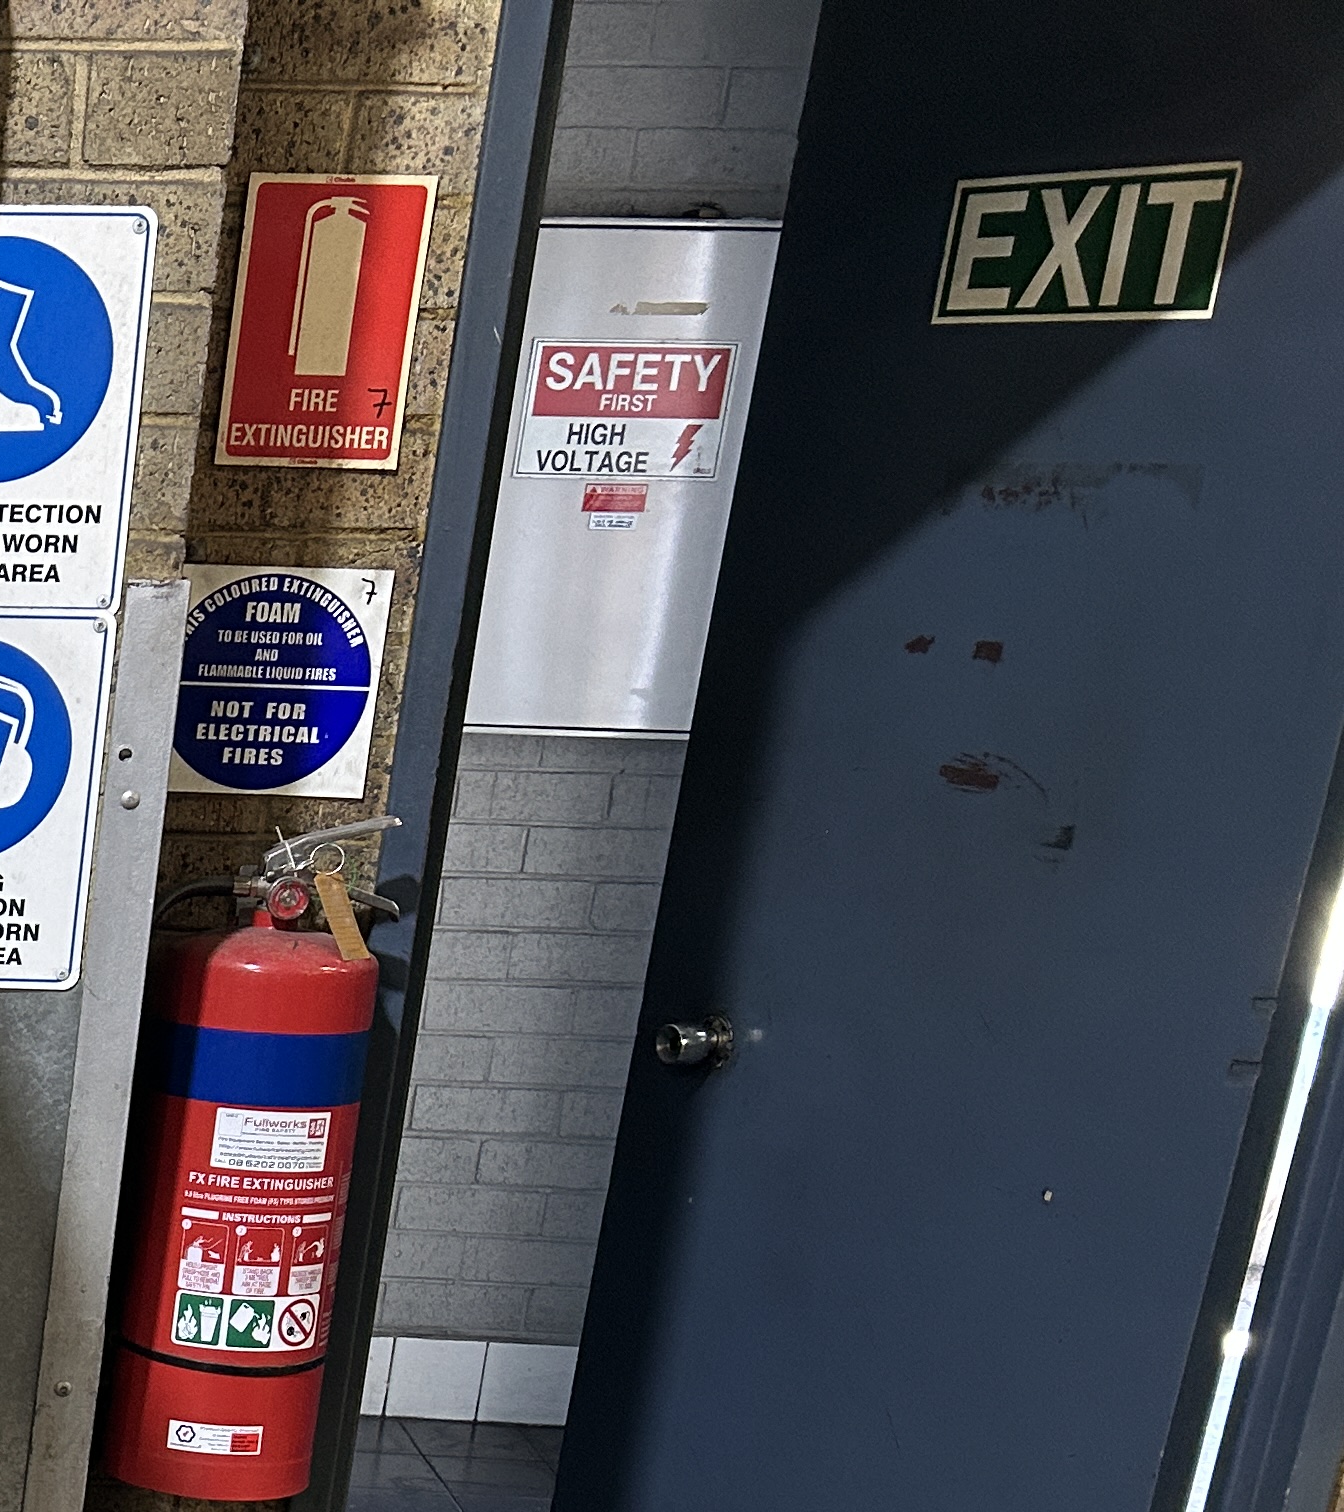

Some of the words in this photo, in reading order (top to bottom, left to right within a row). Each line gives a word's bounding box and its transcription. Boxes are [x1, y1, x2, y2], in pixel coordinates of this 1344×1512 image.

[946, 179, 1227, 311] EXIT
[545, 352, 721, 392] SAFETY
[289, 389, 339, 412] FIRE
[368, 388, 392, 419] 7
[599, 394, 657, 412] FIRST
[230, 423, 389, 449] EXTINGUISHER
[567, 423, 626, 445] HIGH
[537, 450, 649, 473] VOLTAGE
[1, 534, 78, 553] WORN
[362, 578, 377, 605] 7
[204, 576, 279, 613] COLOURED
[282, 577, 364, 648] EXTINGUISHER
[245, 601, 301, 623] FOAM
[218, 630, 232, 643] TO
[234, 630, 249, 643] BE
[251, 631, 280, 643] USED
[282, 632, 304, 645] FOR
[306, 633, 322, 645] OIL
[255, 649, 278, 661] AND
[198, 664, 264, 678] FLAMMABLE
[266, 666, 302, 680] LIQUID
[305, 668, 336, 680] FIRES
[211, 701, 254, 718] NOT
[266, 702, 306, 719] FOR
[196, 723, 320, 743] ELECTRICAL
[222, 747, 283, 765] FIRES
[244, 1117, 307, 1128] Fullworks
[189, 1171, 204, 1184] FX
[208, 1174, 240, 1188] FIRE
[243, 1177, 334, 1191] EXTINGUISHER
[222, 1212, 301, 1224] INSTRUCTIONS
